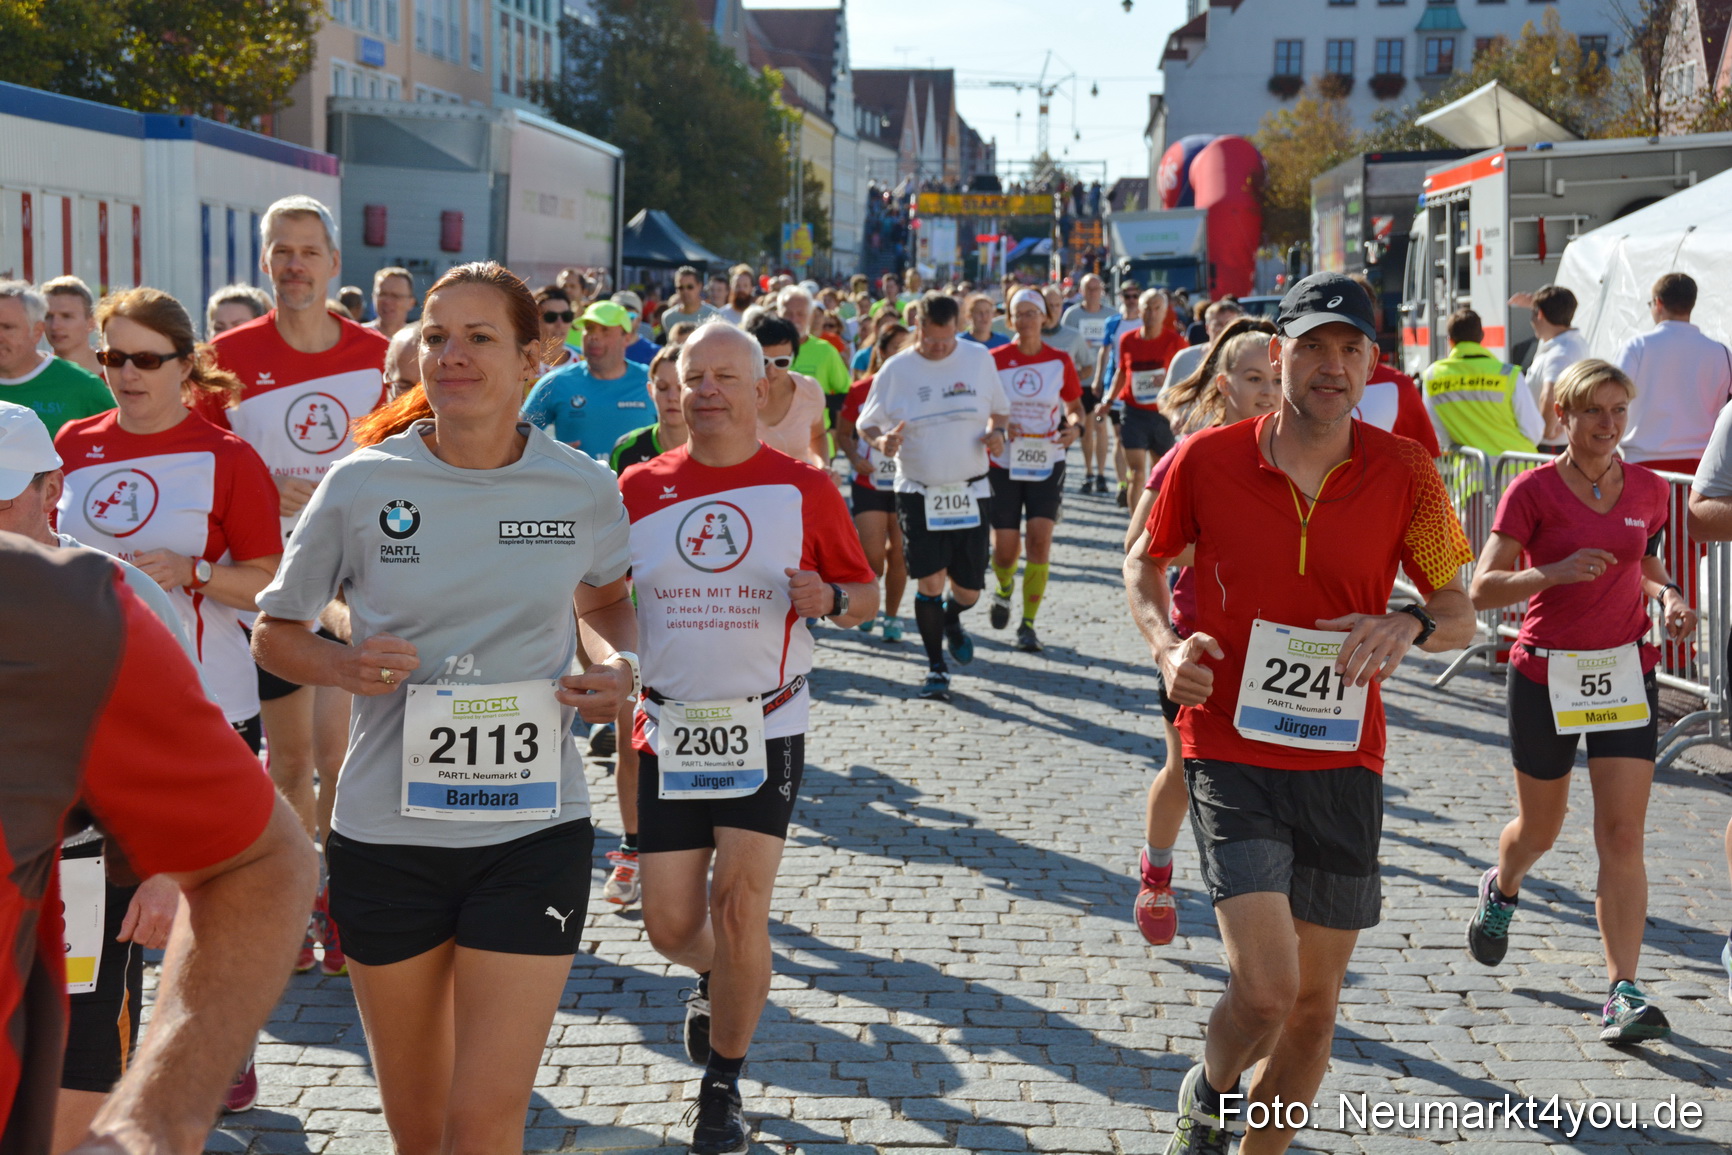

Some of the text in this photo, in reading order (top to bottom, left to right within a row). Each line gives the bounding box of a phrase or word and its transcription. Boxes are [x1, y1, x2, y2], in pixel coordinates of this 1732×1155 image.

[1017, 449, 1047, 463] 2605
[383, 500, 418, 514] BMW
[934, 494, 971, 510] 2104
[499, 521, 576, 538] BOCK
[1624, 517, 1645, 528] Maria
[380, 545, 420, 556] PARTL
[380, 555, 420, 564] Neumarkt
[654, 585, 773, 600] LAUFEN MIT HERZ
[666, 604, 761, 615] Dr. Heck / Dr. Röschl
[666, 619, 760, 631] Leistungsdiagnostik
[1288, 638, 1342, 655] BOCK
[445, 653, 482, 677] 19.
[1580, 672, 1612, 697] 55
[764, 674, 806, 716] ACEFO
[453, 696, 519, 714] BOCK
[686, 707, 731, 719] BOCK
[1267, 698, 1331, 714] PARTL Neumarkt
[1585, 710, 1618, 723] Maria
[1274, 716, 1327, 738] Jürgen
[429, 722, 539, 766] 2113
[674, 725, 749, 756] 2303
[438, 771, 517, 780] PARTL Neumarkt
[691, 774, 735, 790] Jürgen
[446, 789, 519, 807] Barbara
